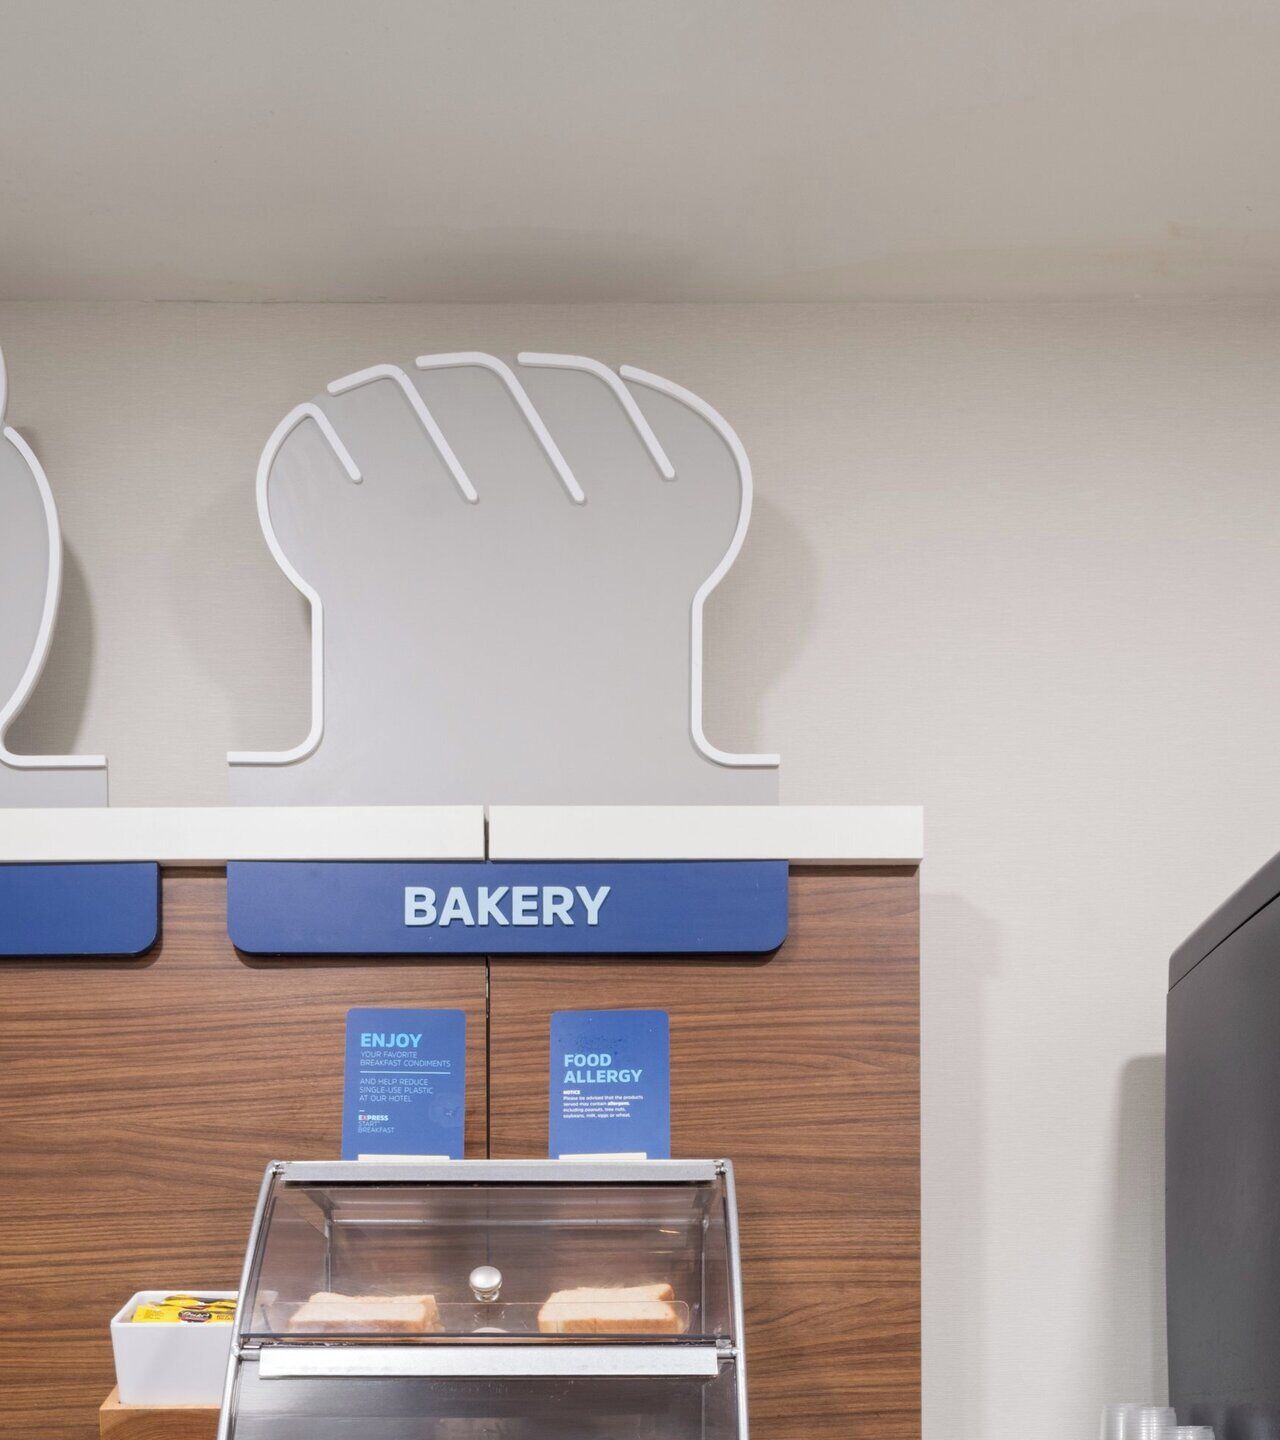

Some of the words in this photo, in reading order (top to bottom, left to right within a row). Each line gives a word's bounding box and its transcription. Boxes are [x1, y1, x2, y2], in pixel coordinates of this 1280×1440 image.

[404, 886, 611, 926] BAKERY
[361, 1032, 422, 1048] ENJOY
[383, 1051, 418, 1059] FAVORITE
[564, 1053, 612, 1067] FOOD
[360, 1059, 401, 1067] BREAKFAST
[404, 1060, 451, 1068] CONDIMENTS
[563, 1069, 643, 1084] ALLERGY
[360, 1086, 402, 1094] SINGLE-USE
[404, 1087, 434, 1095] PLASTIC
